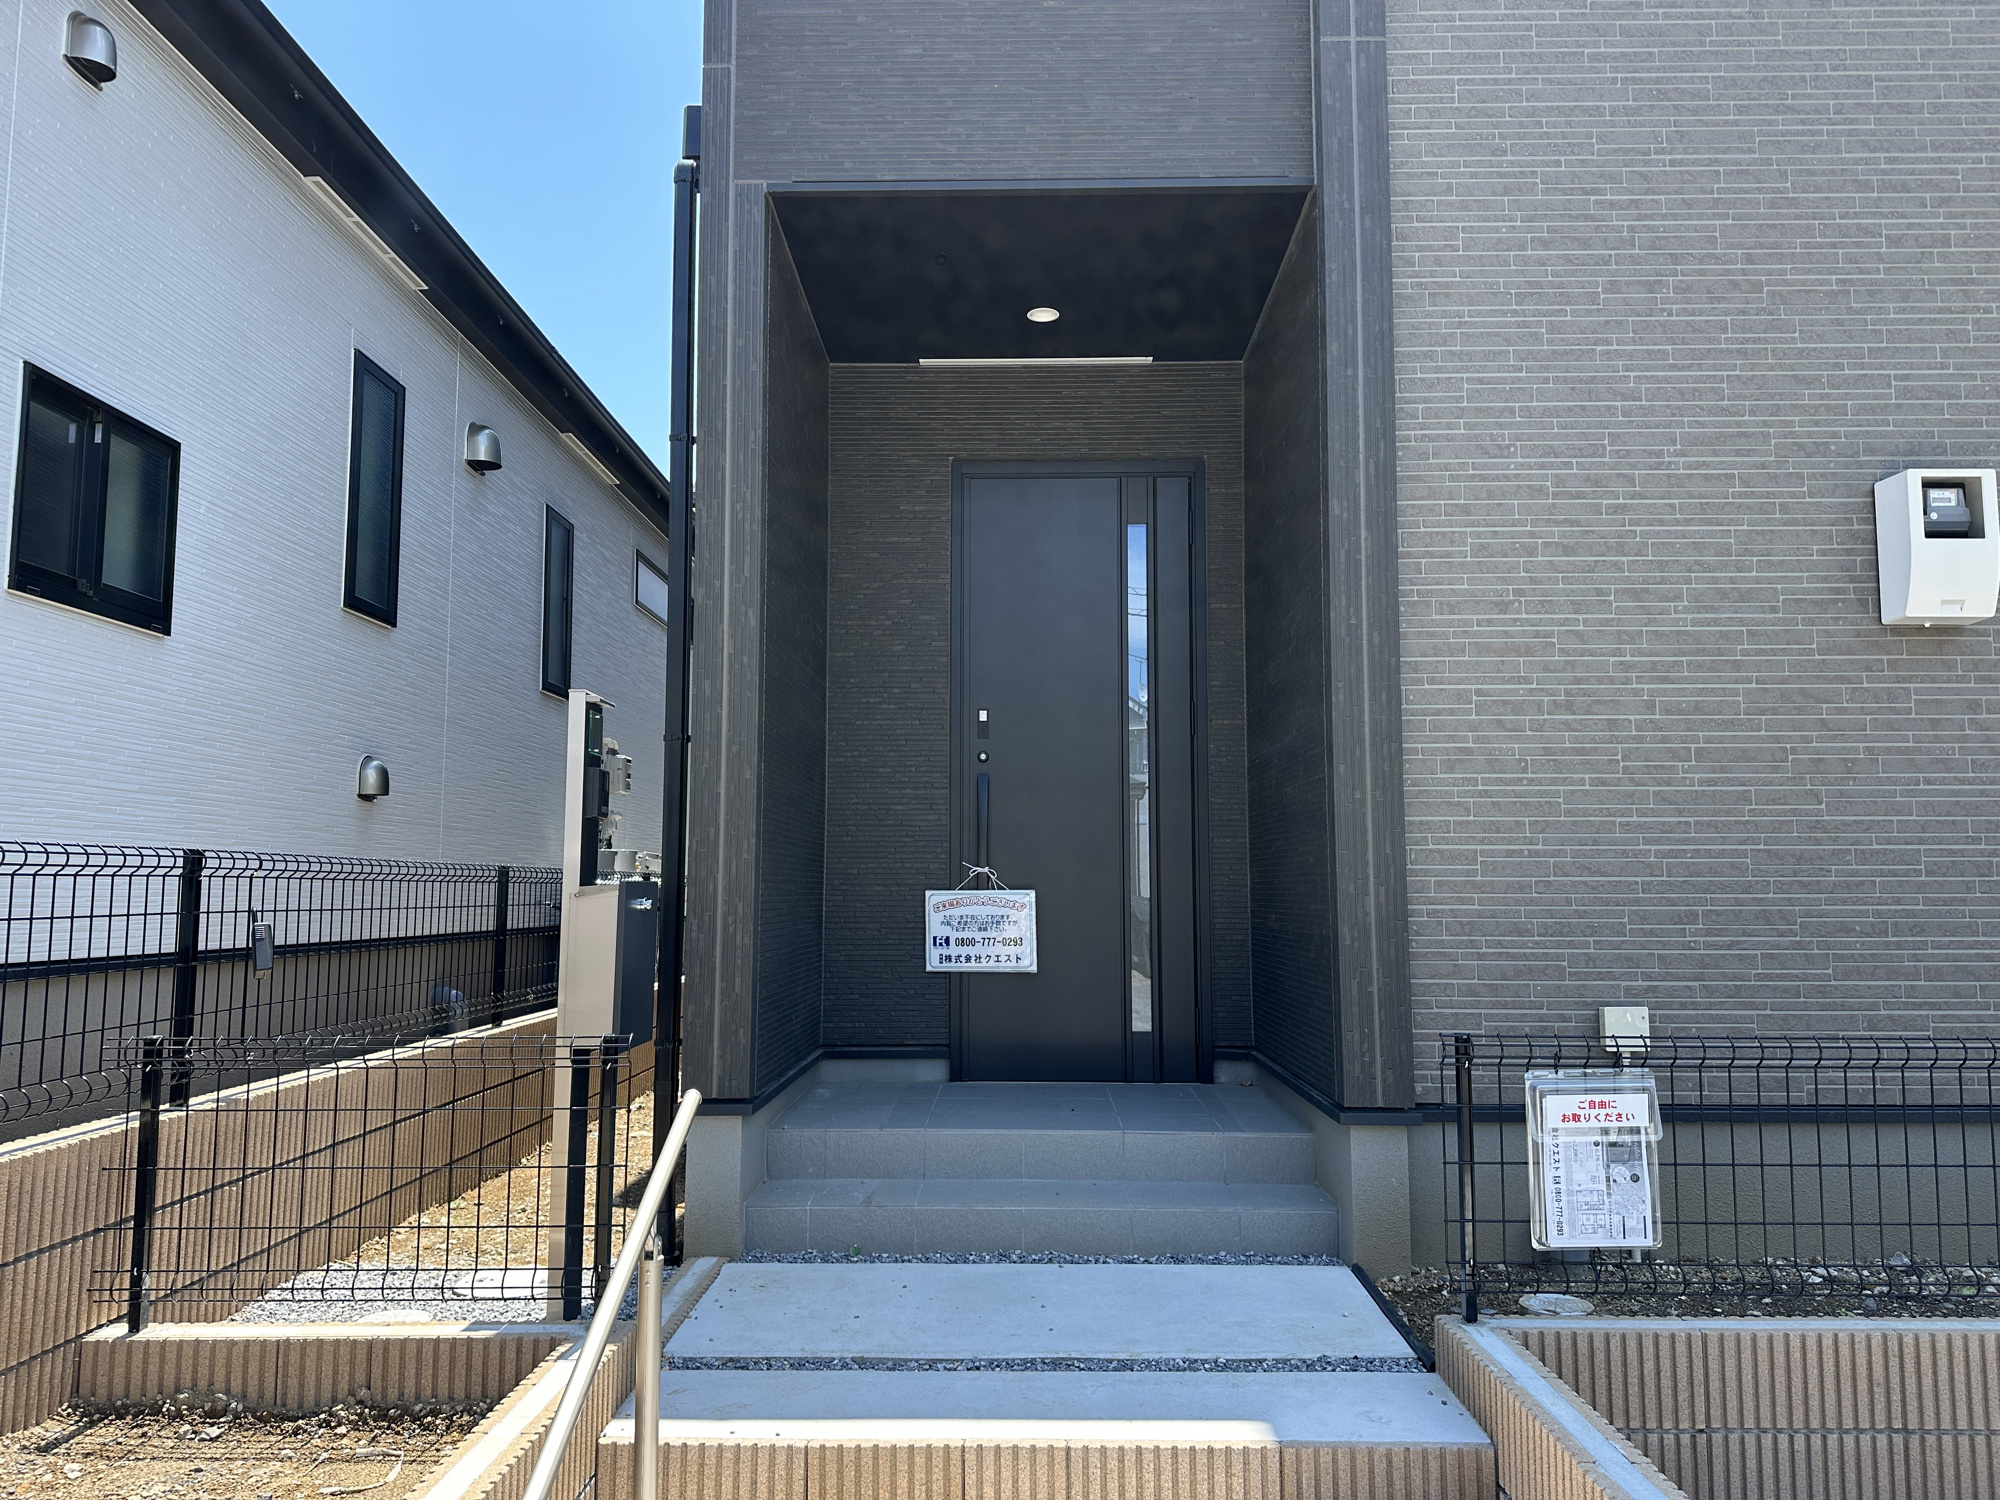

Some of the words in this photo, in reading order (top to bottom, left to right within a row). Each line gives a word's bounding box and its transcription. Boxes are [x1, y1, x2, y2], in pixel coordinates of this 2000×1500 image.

[933, 896, 1027, 913] ご来場ありがとうございます
[955, 937, 1023, 947] 0800-777-0293
[944, 953, 1022, 964] 株式会社クエスト
[1577, 1099, 1618, 1110] ご自由に
[1560, 1112, 1636, 1124] お取りください
[1554, 1187, 1564, 1237] 0800-777-0293
